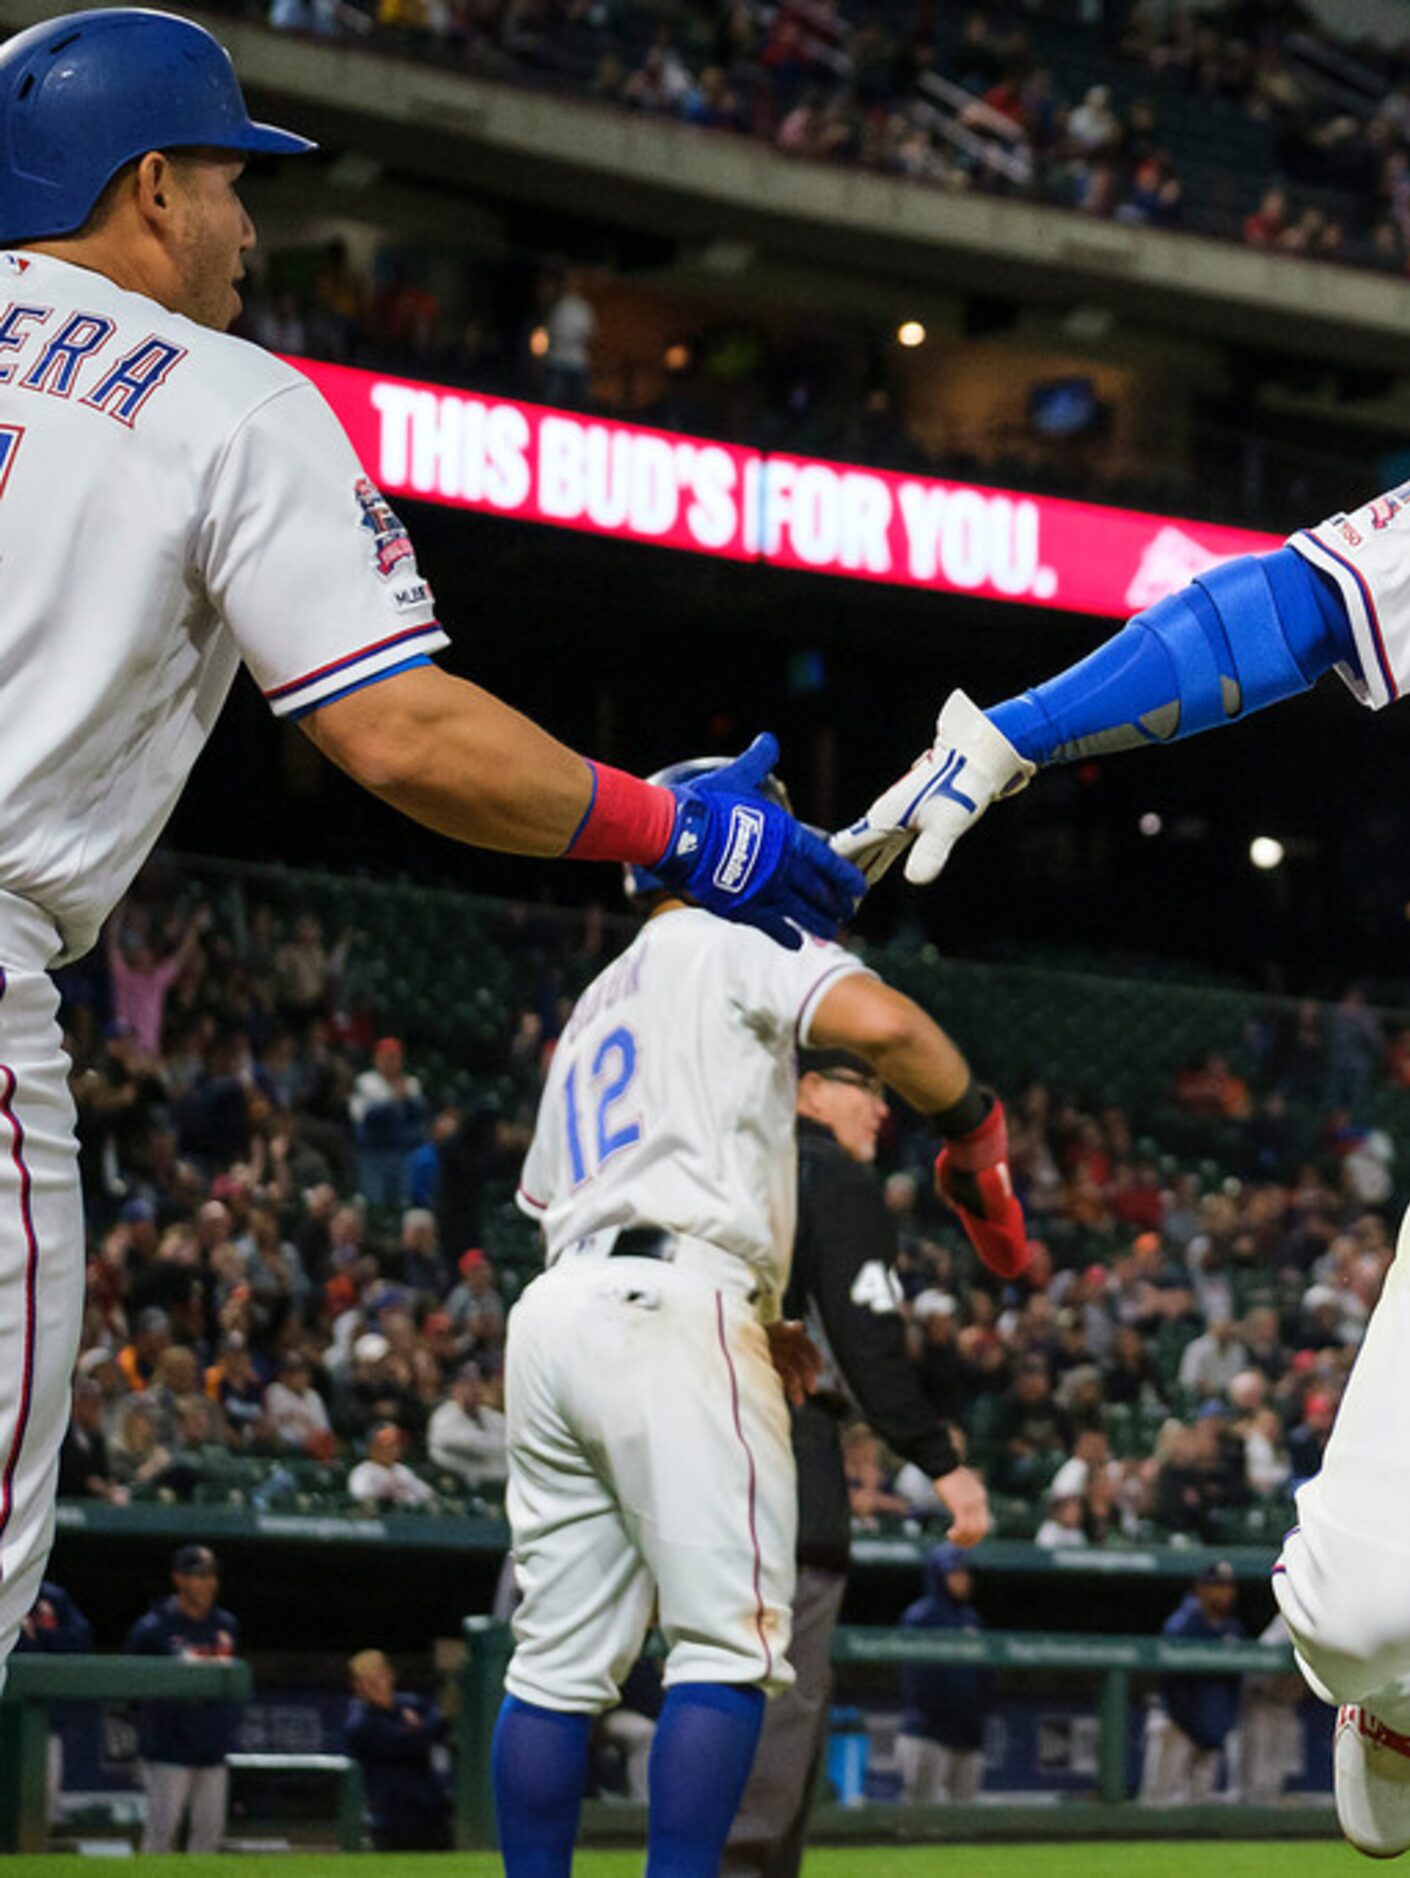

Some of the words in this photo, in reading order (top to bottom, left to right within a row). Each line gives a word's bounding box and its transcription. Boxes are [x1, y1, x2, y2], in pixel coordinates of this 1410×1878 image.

[371, 381, 531, 510] THIS
[538, 415, 737, 548] BUD'S
[743, 457, 892, 574] FOR
[899, 481, 1058, 599] YOU.
[562, 1021, 644, 1193] 12
